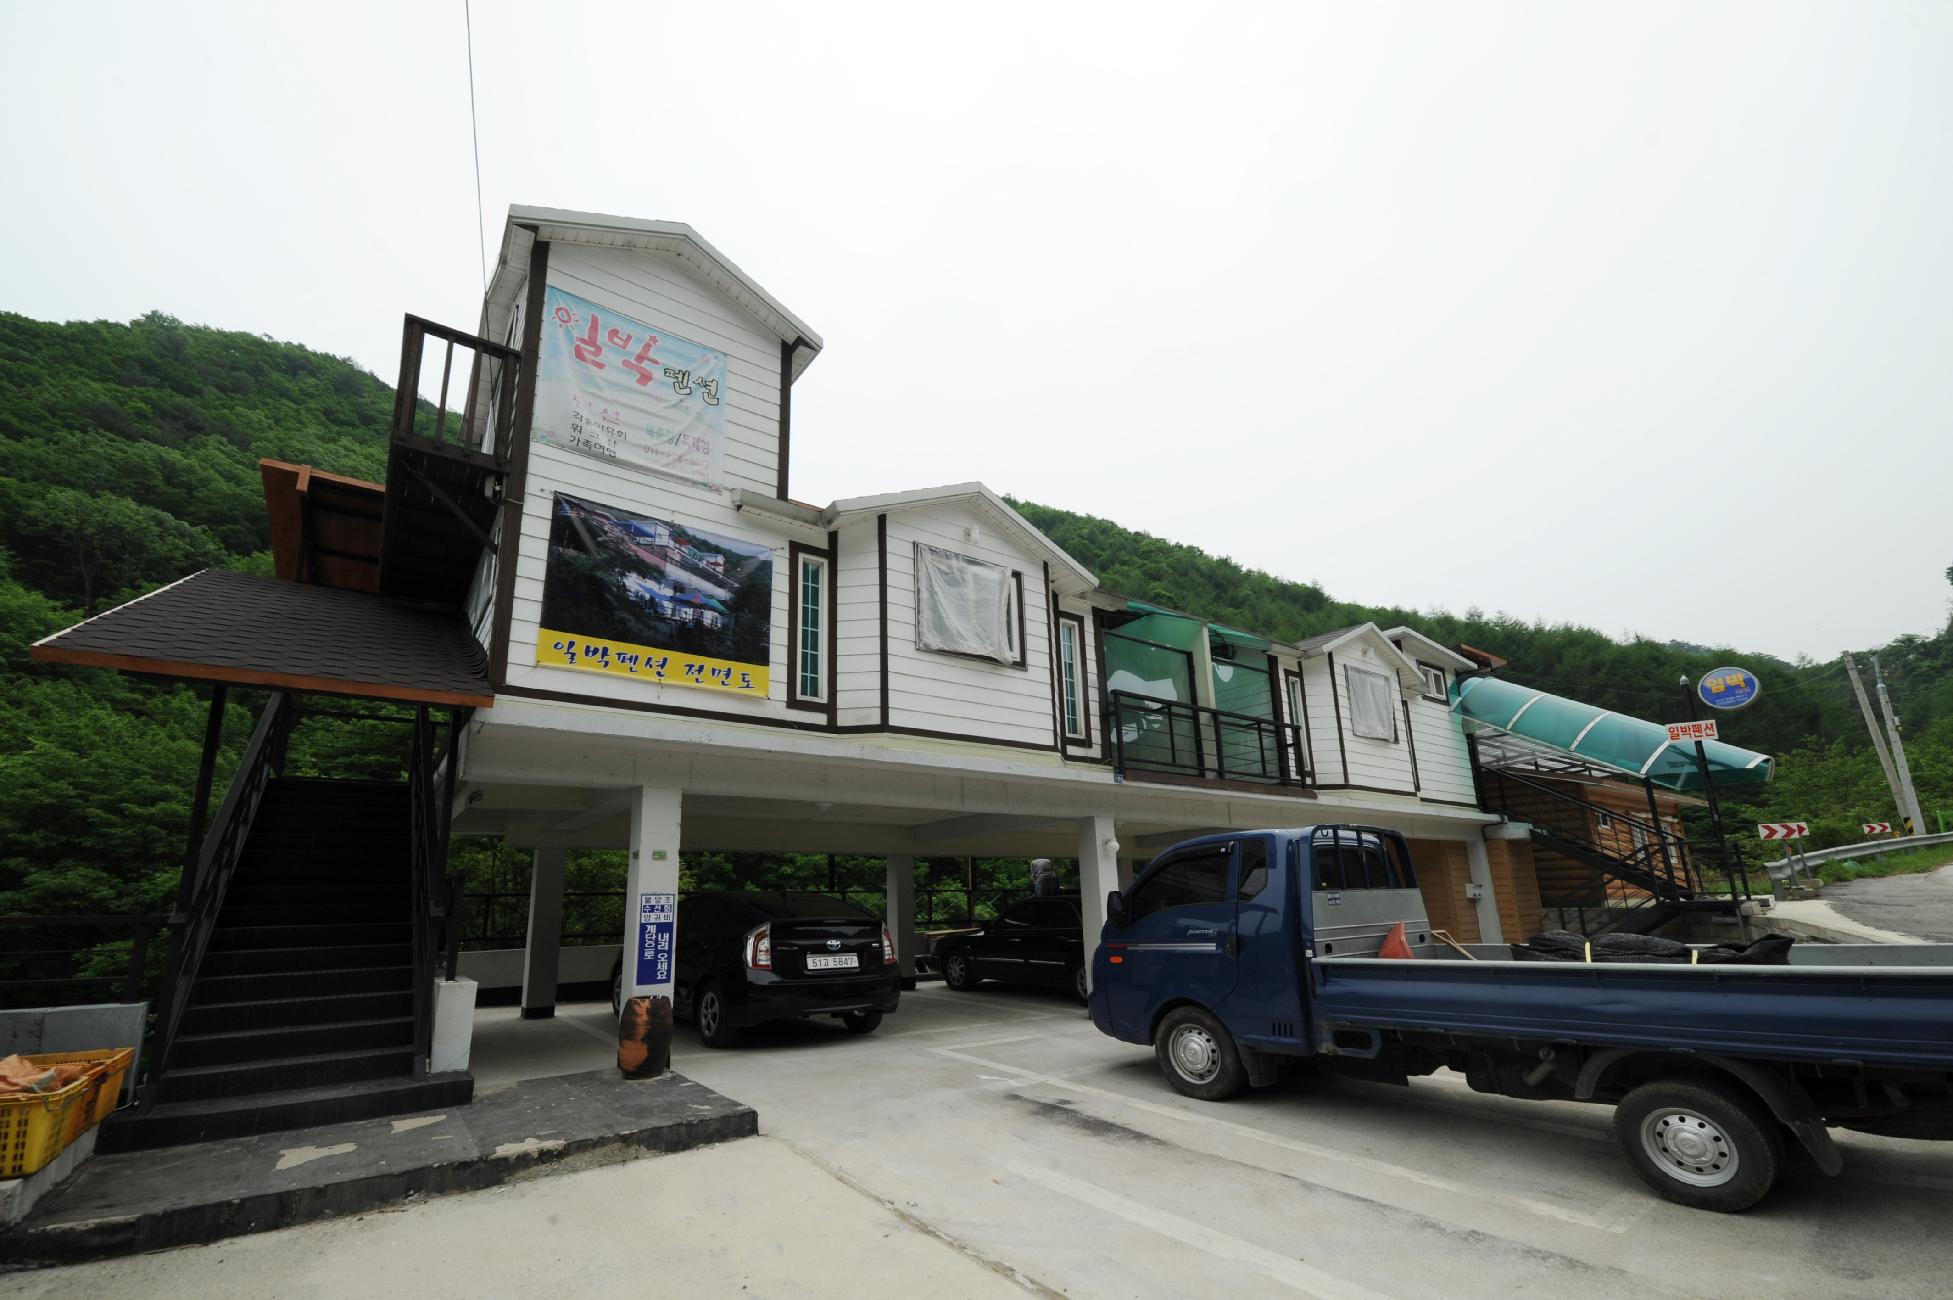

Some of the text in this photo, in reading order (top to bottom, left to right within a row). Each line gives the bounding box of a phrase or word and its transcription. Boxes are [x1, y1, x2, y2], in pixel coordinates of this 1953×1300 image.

[663, 367, 720, 406] 펜션
[553, 640, 755, 689] 일박펜션 전면도
[1703, 672, 1747, 694] 일박
[1668, 722, 1715, 741] 일박펜션
[643, 913, 671, 923] 양귀비
[644, 904, 672, 913] 수선화
[643, 925, 656, 960] 계단으로
[832, 957, 854, 967] 5847
